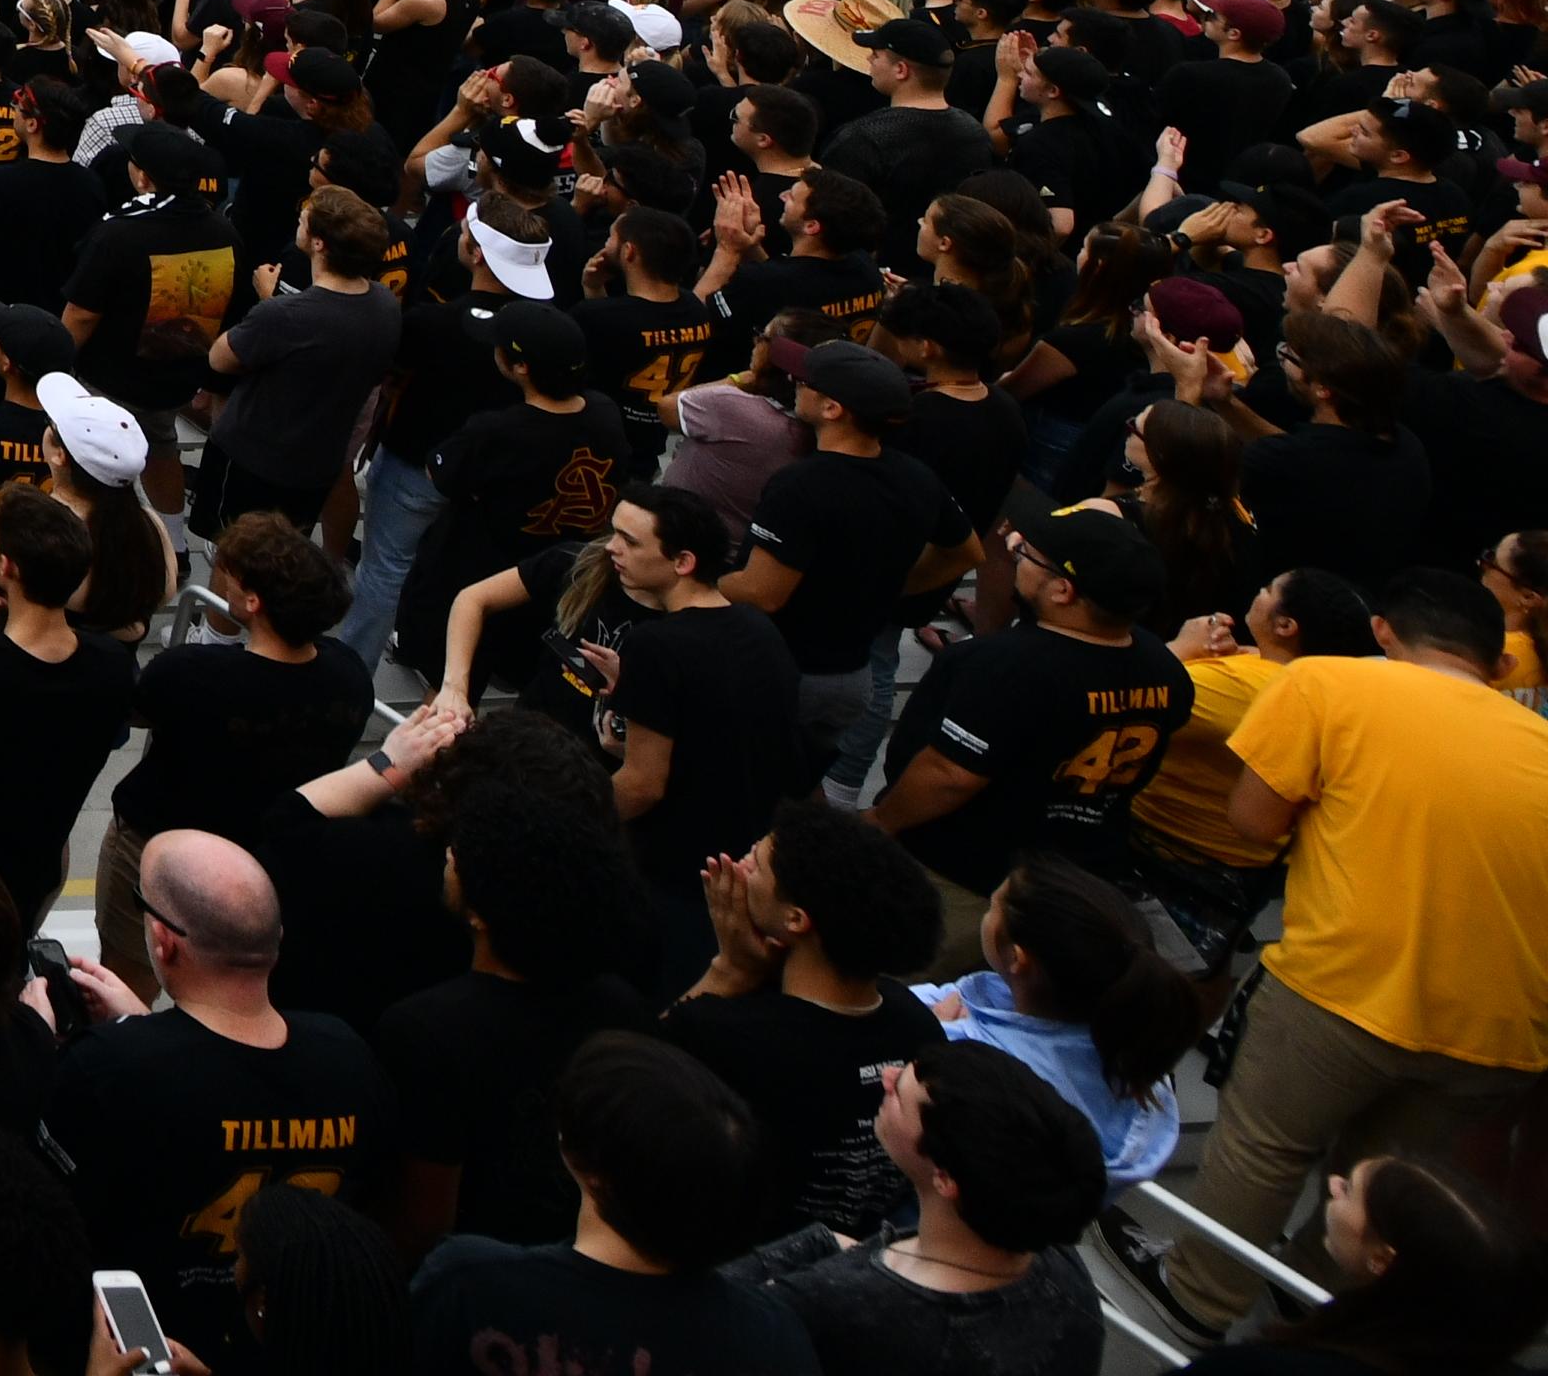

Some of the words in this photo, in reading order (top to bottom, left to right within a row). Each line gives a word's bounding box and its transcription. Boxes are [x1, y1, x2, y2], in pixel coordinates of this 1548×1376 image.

[821, 291, 883, 317] TILLMAN
[642, 322, 714, 347] TILLMAN
[1088, 685, 1169, 716] TILLMAN
[1054, 723, 1160, 795] 42
[221, 1114, 356, 1153] TILLMAN
